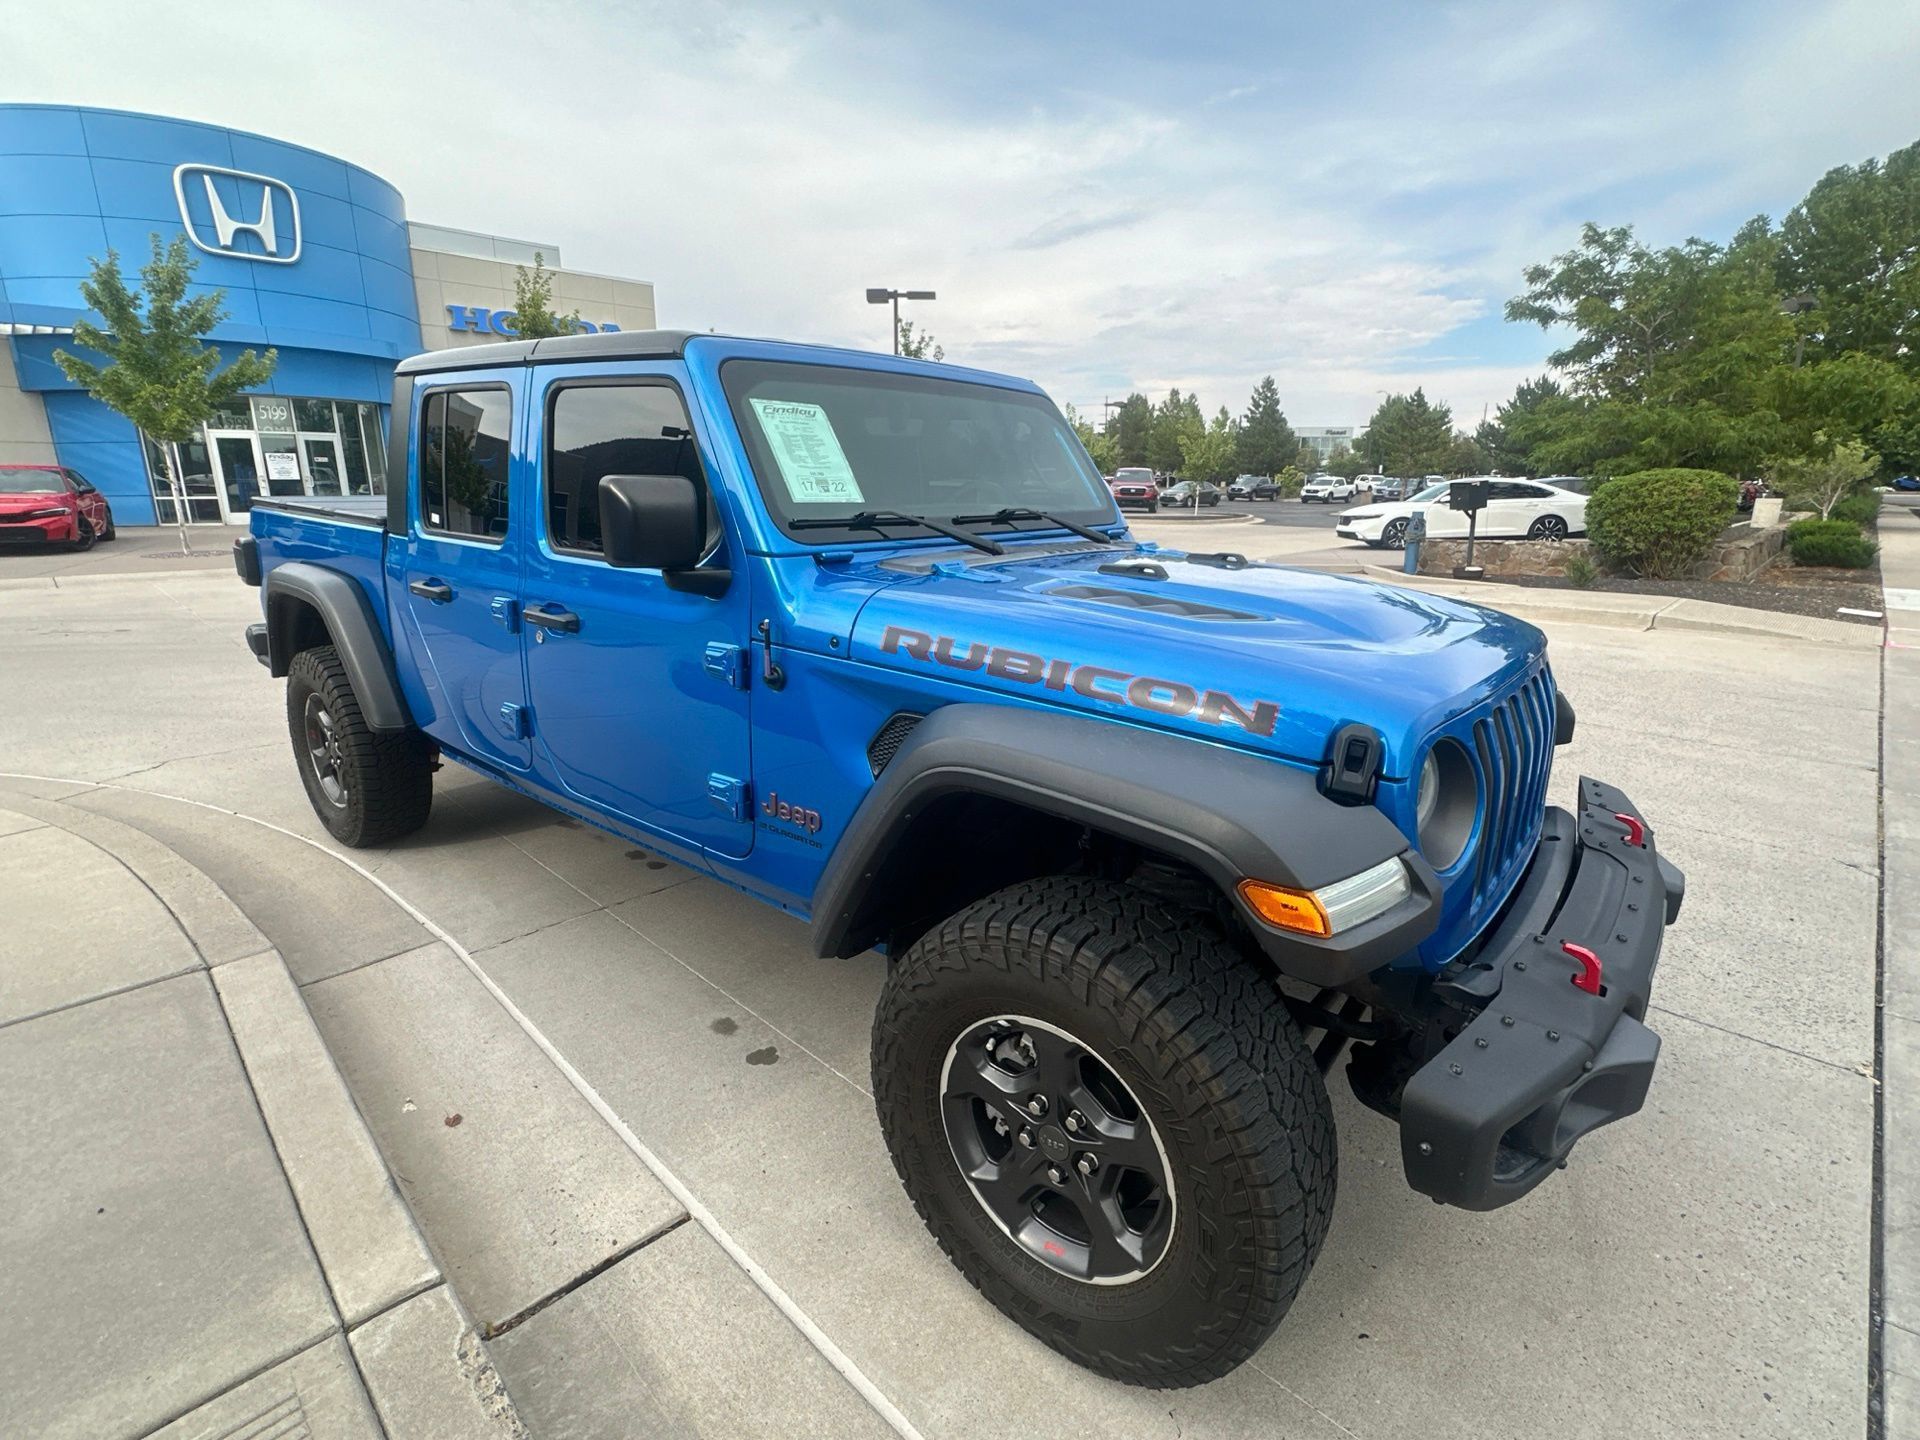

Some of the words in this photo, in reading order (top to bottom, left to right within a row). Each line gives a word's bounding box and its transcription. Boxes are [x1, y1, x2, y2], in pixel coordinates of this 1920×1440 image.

[446, 304, 622, 337] HOD
[259, 405, 287, 420] 5199
[763, 405, 816, 418] Findlay
[801, 481, 814, 491] 17
[831, 481, 847, 492] 22
[880, 625, 1280, 738] RUBICON
[761, 792, 823, 834] Jeep
